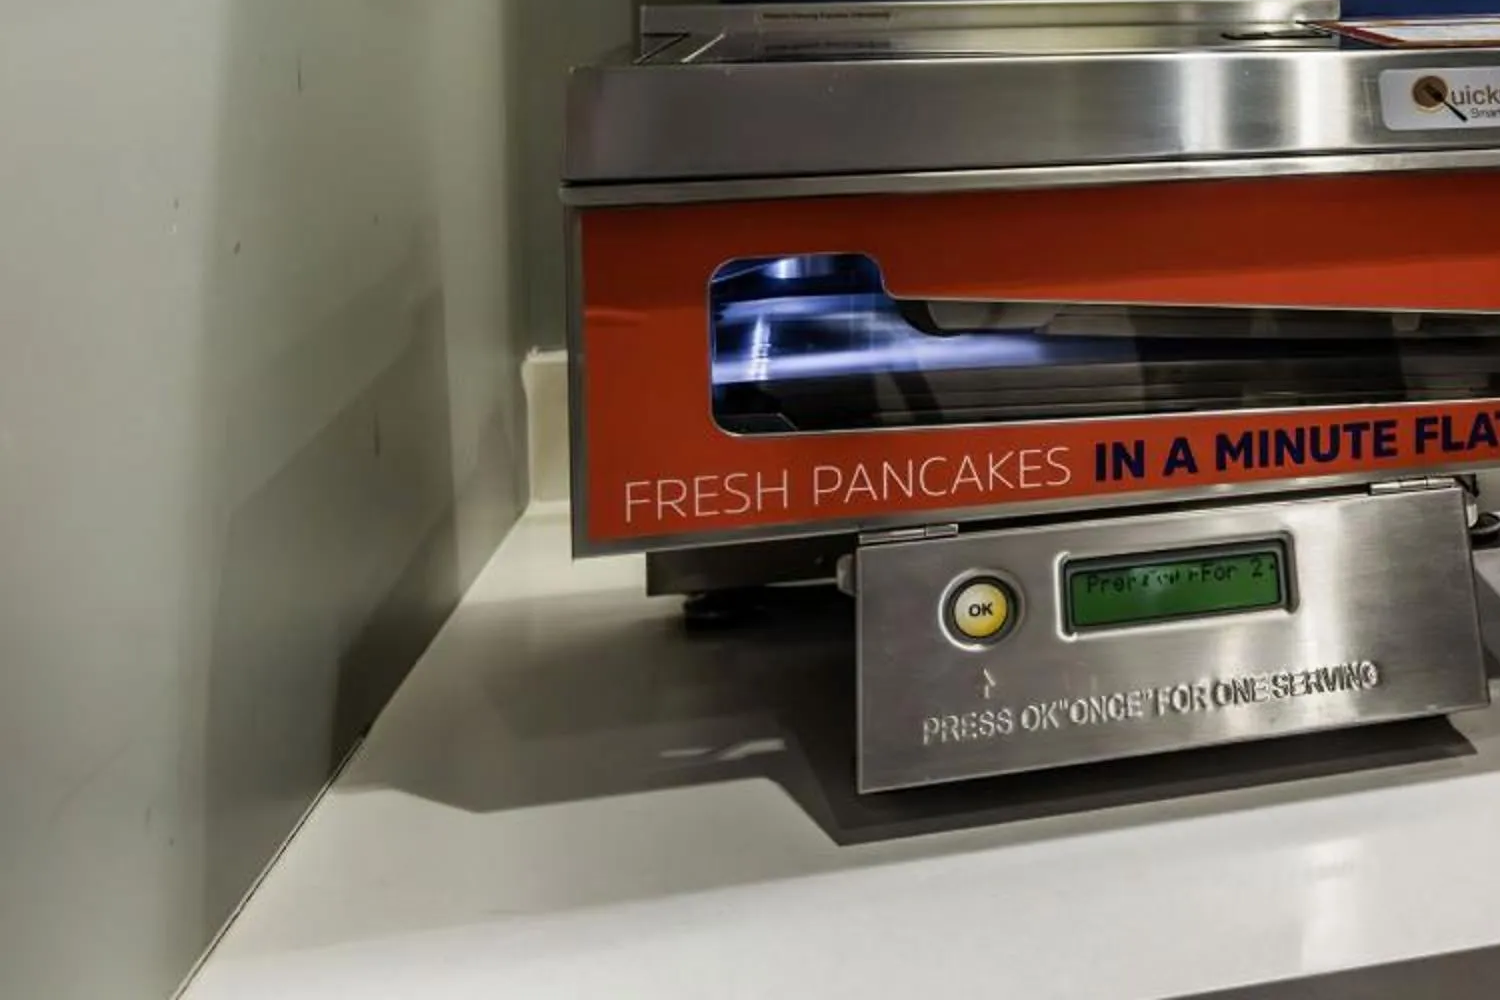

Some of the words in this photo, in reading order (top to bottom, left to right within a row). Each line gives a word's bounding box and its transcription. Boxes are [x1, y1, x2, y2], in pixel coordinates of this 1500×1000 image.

[624, 469, 789, 523] FRESH
[812, 446, 1072, 506] PANCAKES
[1095, 440, 1146, 482] IN
[1162, 437, 1198, 477] A
[1215, 419, 1398, 472] MINUTE
[968, 601, 993, 617] OK
[922, 708, 1014, 745] PRESS
[1154, 680, 1213, 716] FOR
[1211, 672, 1270, 707] ONE
[1269, 659, 1380, 700] SERVING
